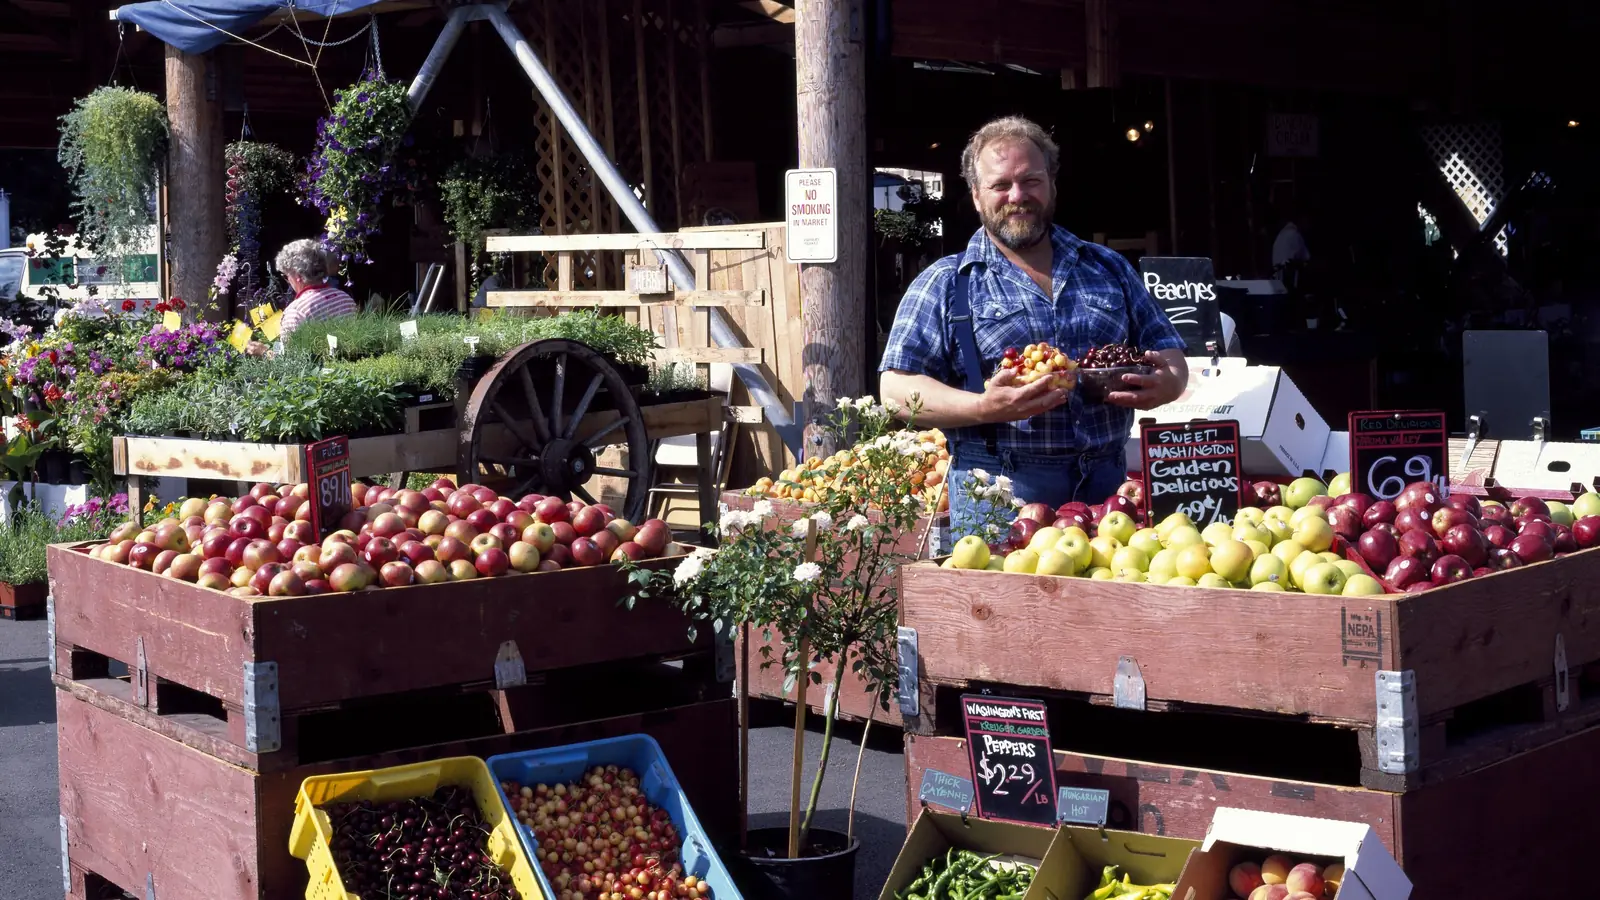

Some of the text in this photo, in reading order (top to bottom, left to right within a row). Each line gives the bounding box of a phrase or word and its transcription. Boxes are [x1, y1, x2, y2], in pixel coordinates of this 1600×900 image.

[799, 178, 821, 187] PLEASE
[804, 189, 817, 201] NO
[792, 204, 831, 216] SMOKING
[793, 218, 828, 227] IN MARKET
[1143, 271, 1217, 304] Peaches
[1360, 418, 1383, 431] RED
[1158, 429, 1218, 444] SWEET!
[322, 445, 343, 458] FUJI
[1148, 444, 1235, 459] WASHINGTON
[1150, 460, 1232, 478] Golden
[1367, 455, 1433, 500] 69
[1151, 477, 1240, 497] Delicious
[1347, 623, 1377, 639] NEPA
[966, 703, 1045, 721] WASHINGTON'S FIRST
[980, 721, 1017, 735] KREUGER
[982, 734, 1036, 758] PEPPERS
[932, 772, 961, 789] THICK
[921, 782, 969, 803] CAYENNE
[1062, 788, 1106, 802] HUNGARIAN
[1071, 803, 1090, 817] HOT
